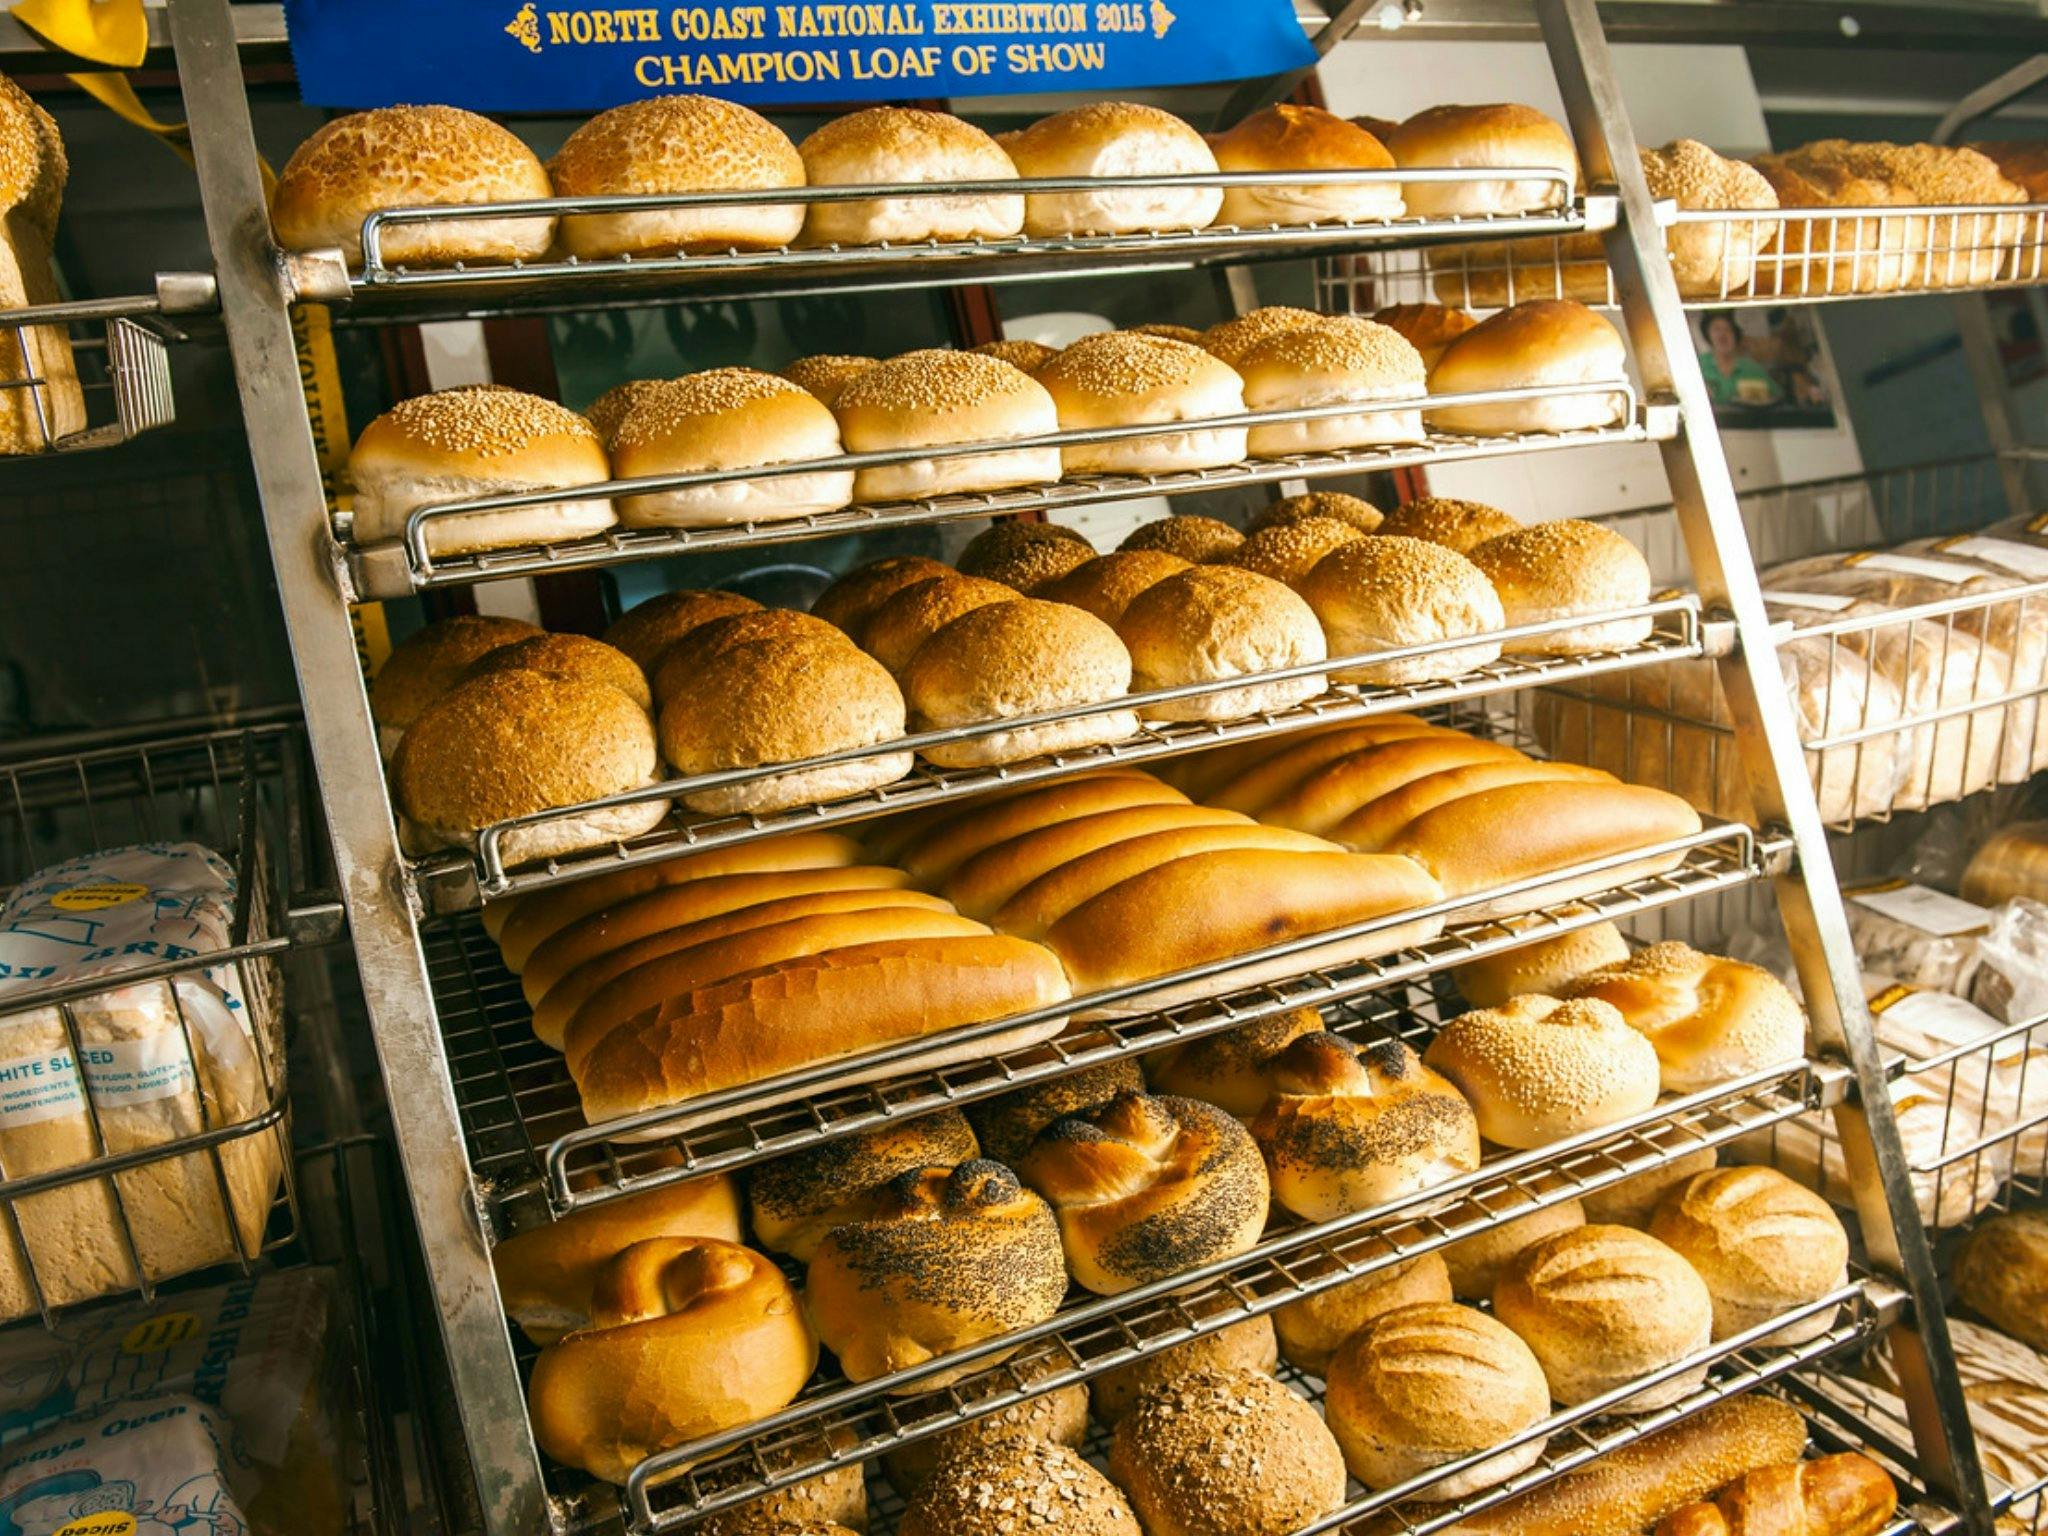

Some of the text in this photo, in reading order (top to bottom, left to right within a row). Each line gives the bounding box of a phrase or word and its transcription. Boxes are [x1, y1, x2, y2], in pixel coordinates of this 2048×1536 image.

[546, 3, 1146, 44] NORTH COAST NATIONAL EXHIBITION 2015
[634, 43, 1106, 87] CHAMPION LOAF OF SHOW
[0, 1048, 114, 1082] HITE SLCED
